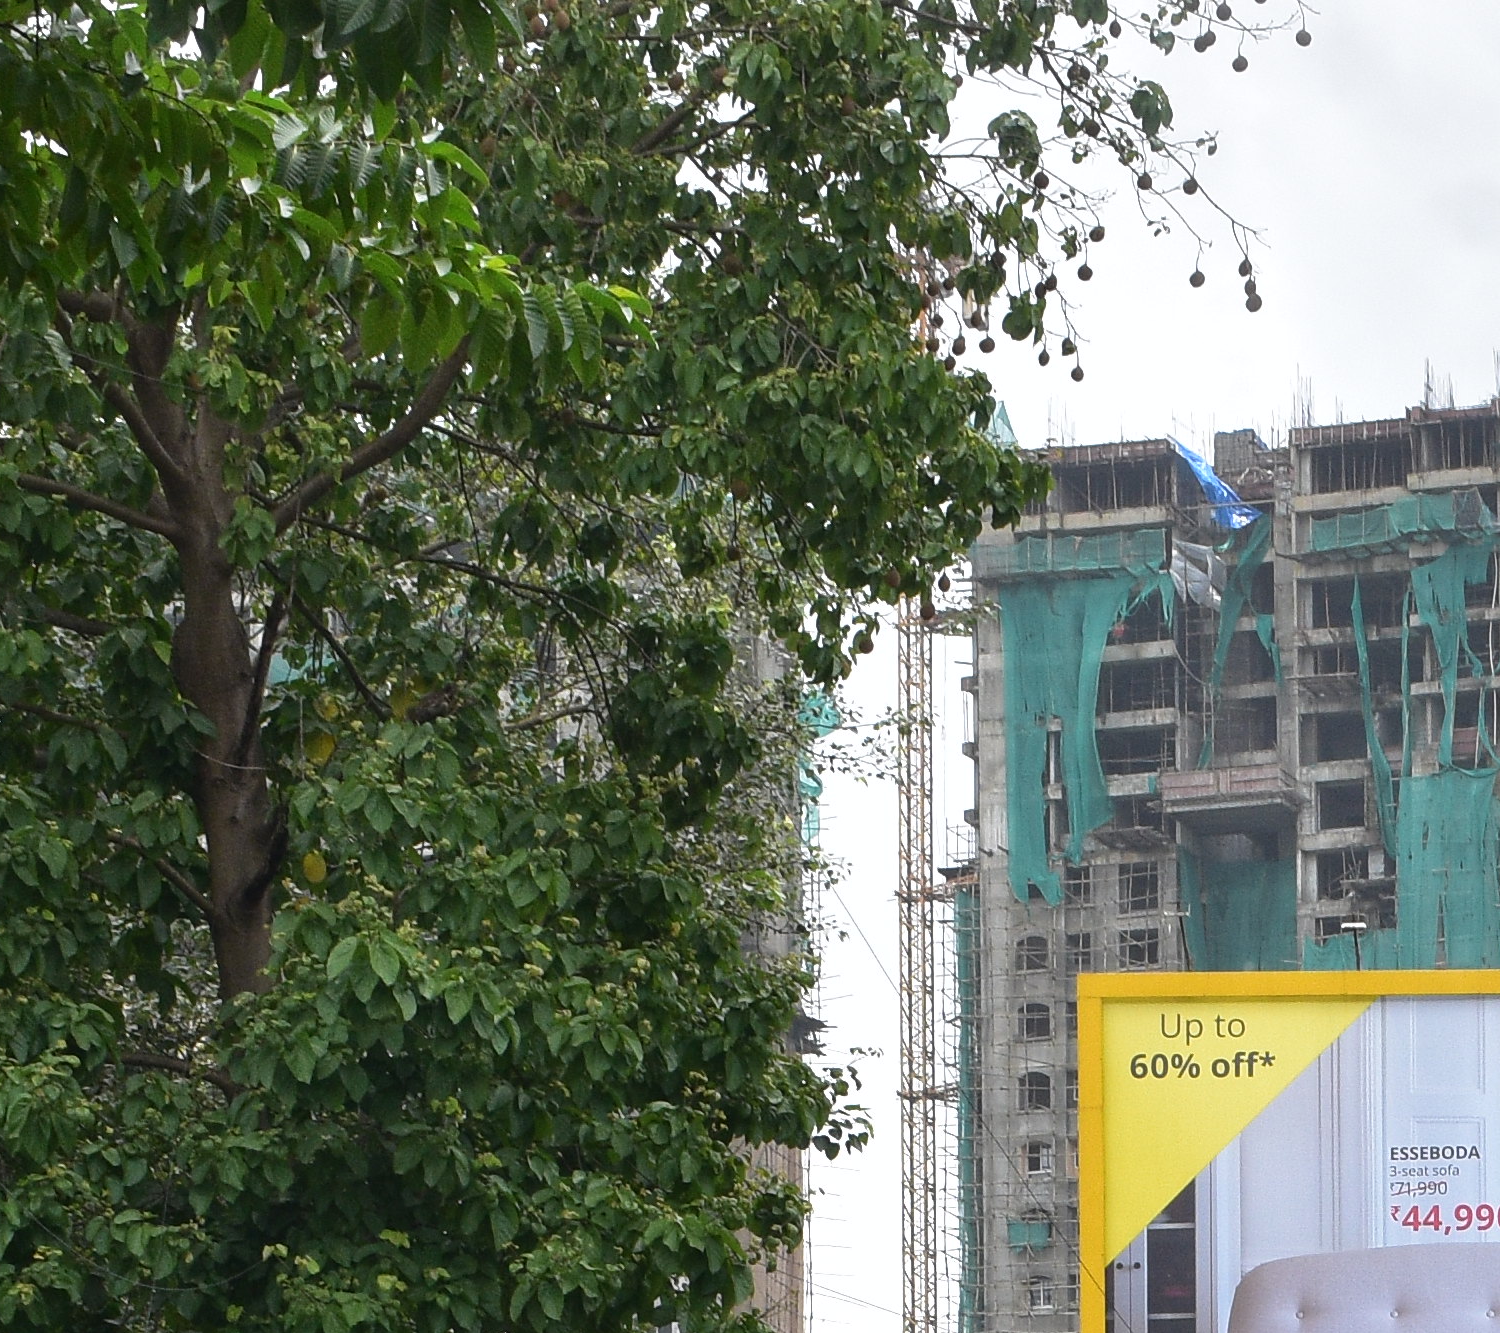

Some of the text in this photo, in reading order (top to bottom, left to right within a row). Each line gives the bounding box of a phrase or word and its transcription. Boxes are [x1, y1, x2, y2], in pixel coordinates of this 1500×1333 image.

[1160, 1013, 1246, 1043] Up to
[1130, 1053, 1201, 1080] 60%
[1390, 1145, 1480, 1161] ESSEBODA
[1389, 1164, 1460, 1177] 3-seat sofa
